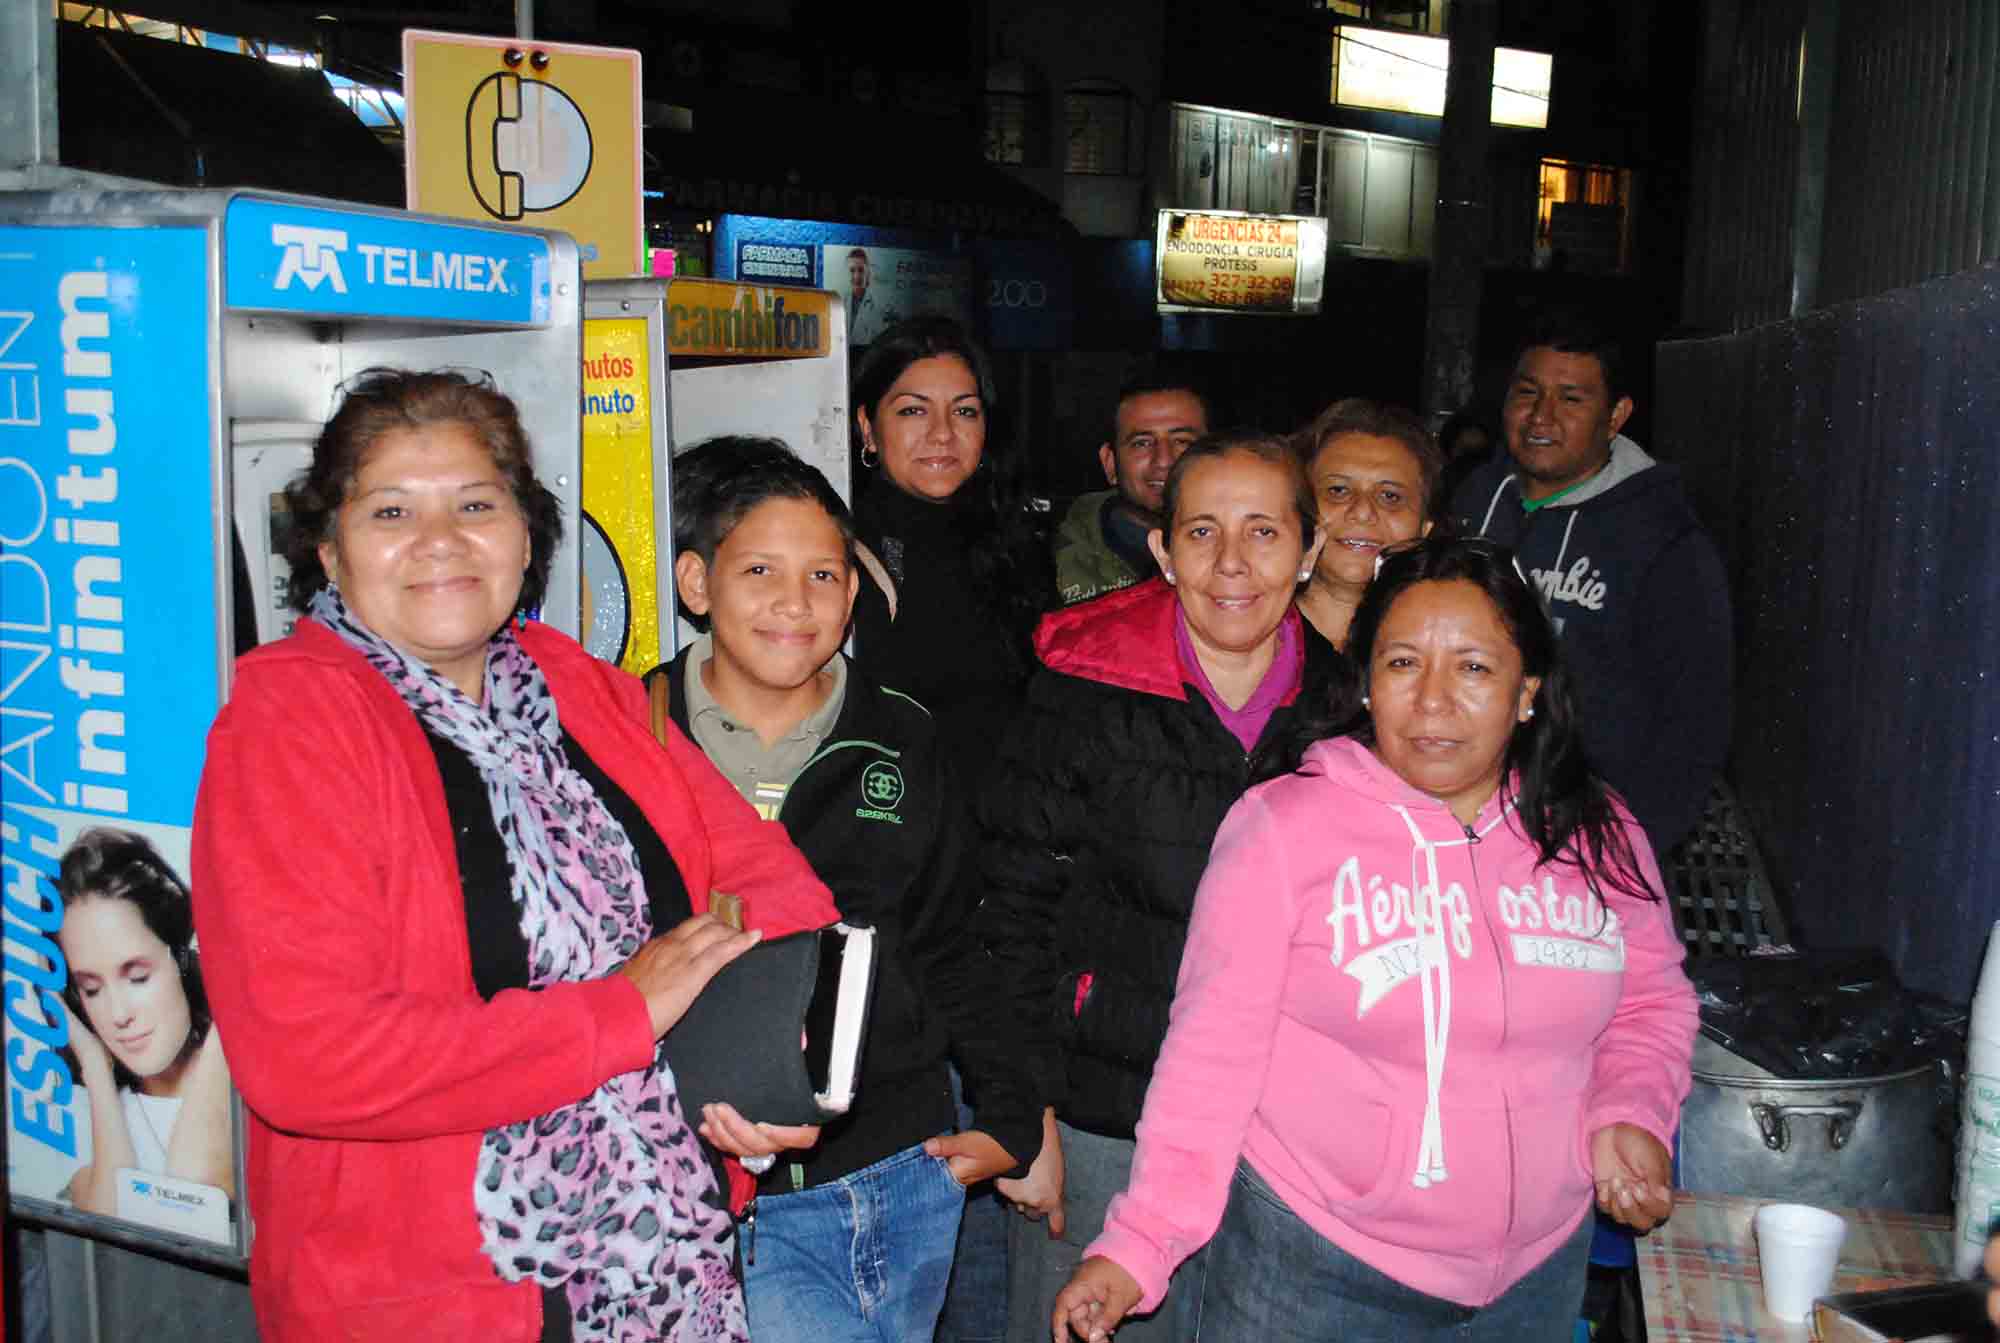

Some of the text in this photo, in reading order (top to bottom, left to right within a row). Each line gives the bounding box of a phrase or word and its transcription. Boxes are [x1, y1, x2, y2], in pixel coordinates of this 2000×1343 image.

[1193, 216, 1264, 243] URGENCIAS
[1167, 239, 1294, 258] ENDODONCIA CIRUGIA
[357, 243, 510, 294] TELMEX
[1203, 257, 1258, 271] PROTESIS
[583, 351, 634, 380] nutos
[583, 387, 635, 415] inuto
[54, 271, 129, 813] infinitum
